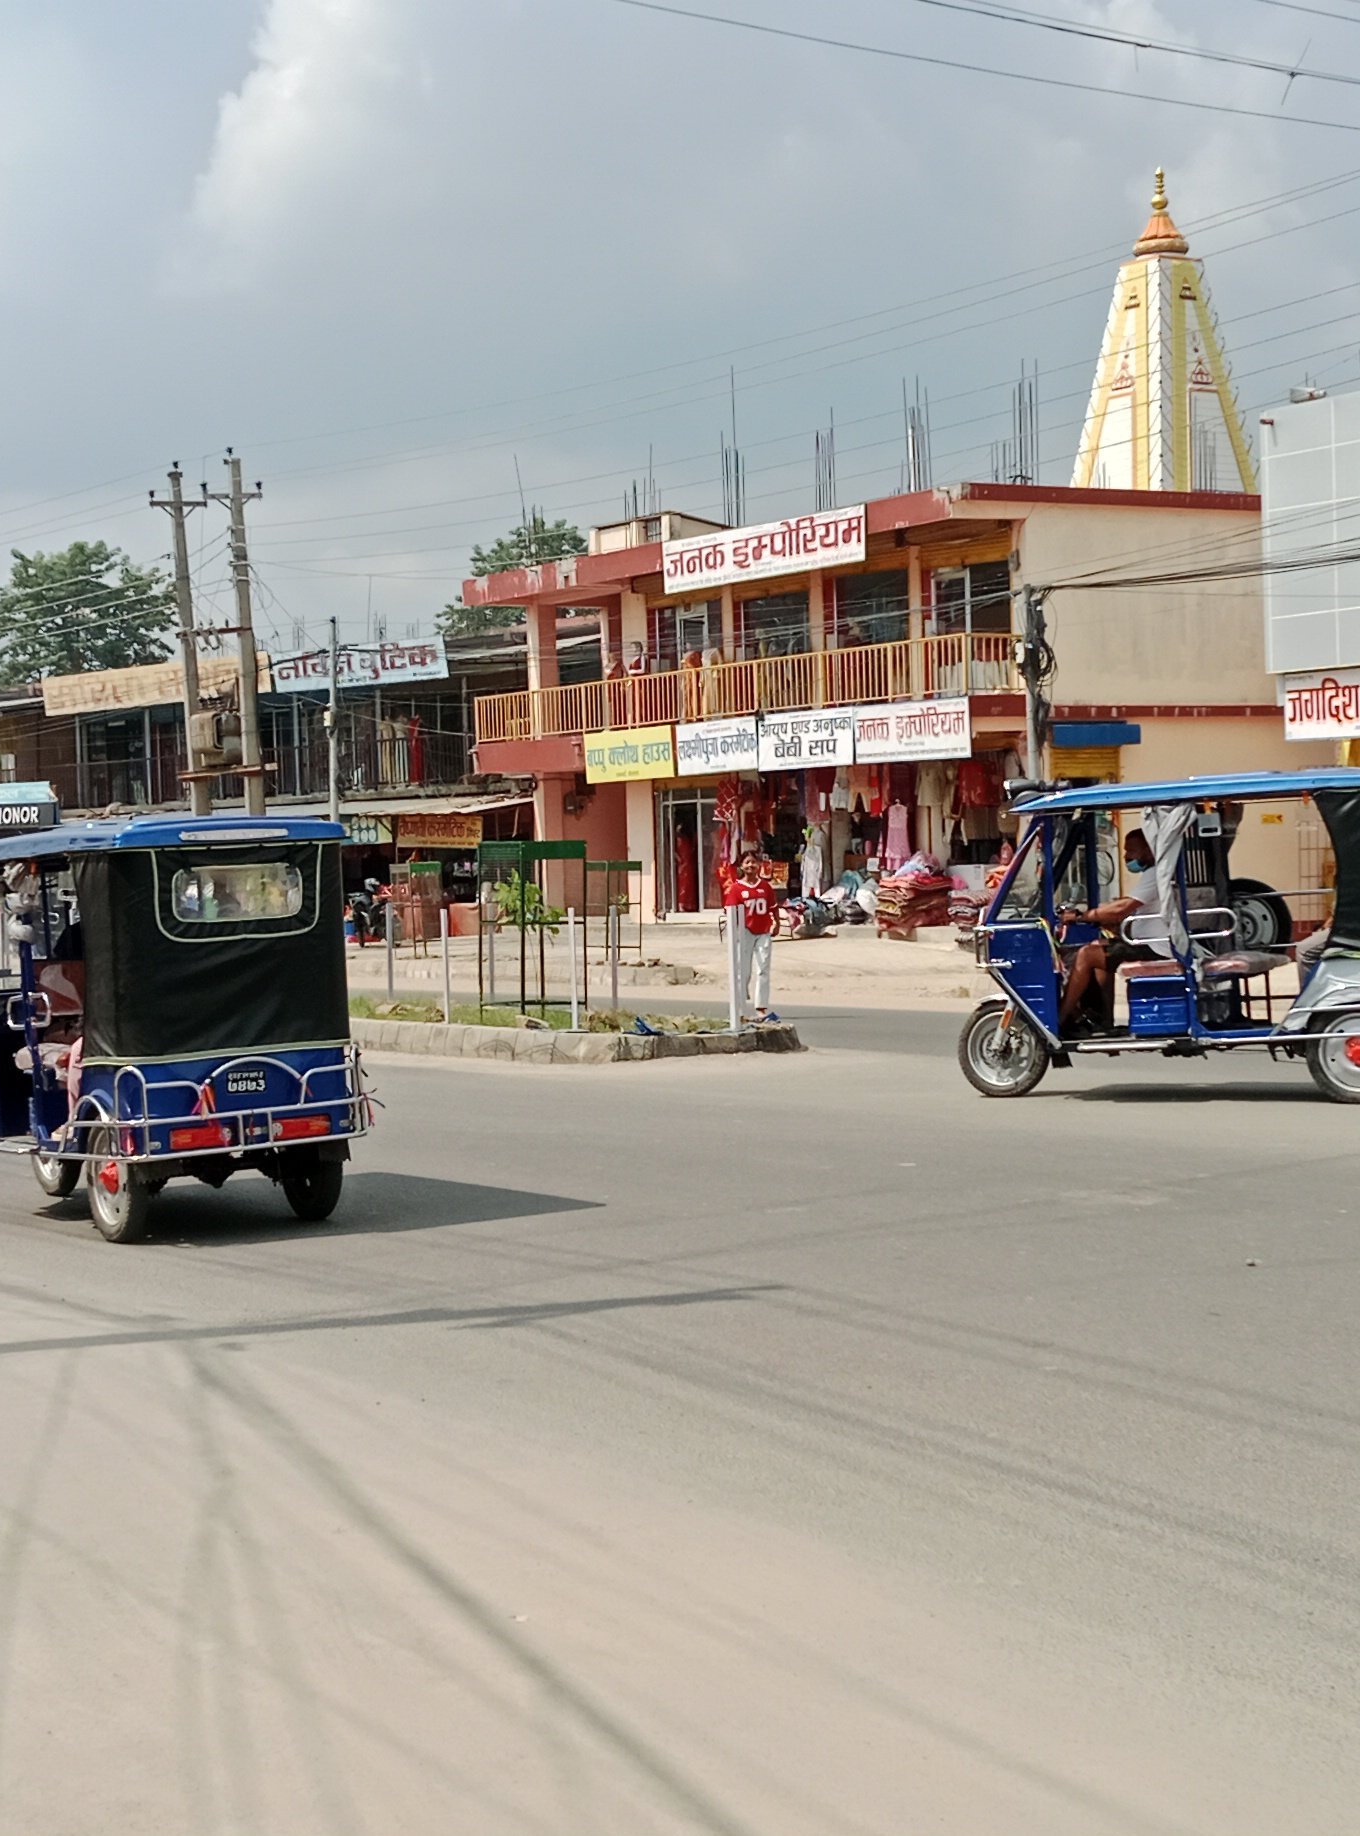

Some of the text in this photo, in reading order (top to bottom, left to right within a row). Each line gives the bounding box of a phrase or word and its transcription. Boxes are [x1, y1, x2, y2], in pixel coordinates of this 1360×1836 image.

[666, 542, 725, 578] जनक
[733, 516, 864, 569] इम्पोरियम
[812, 716, 852, 737] अनुष्का
[856, 707, 966, 745] जनक इम्पोरियम
[642, 742, 671, 765] हाउस
[773, 735, 802, 758] बेबी
